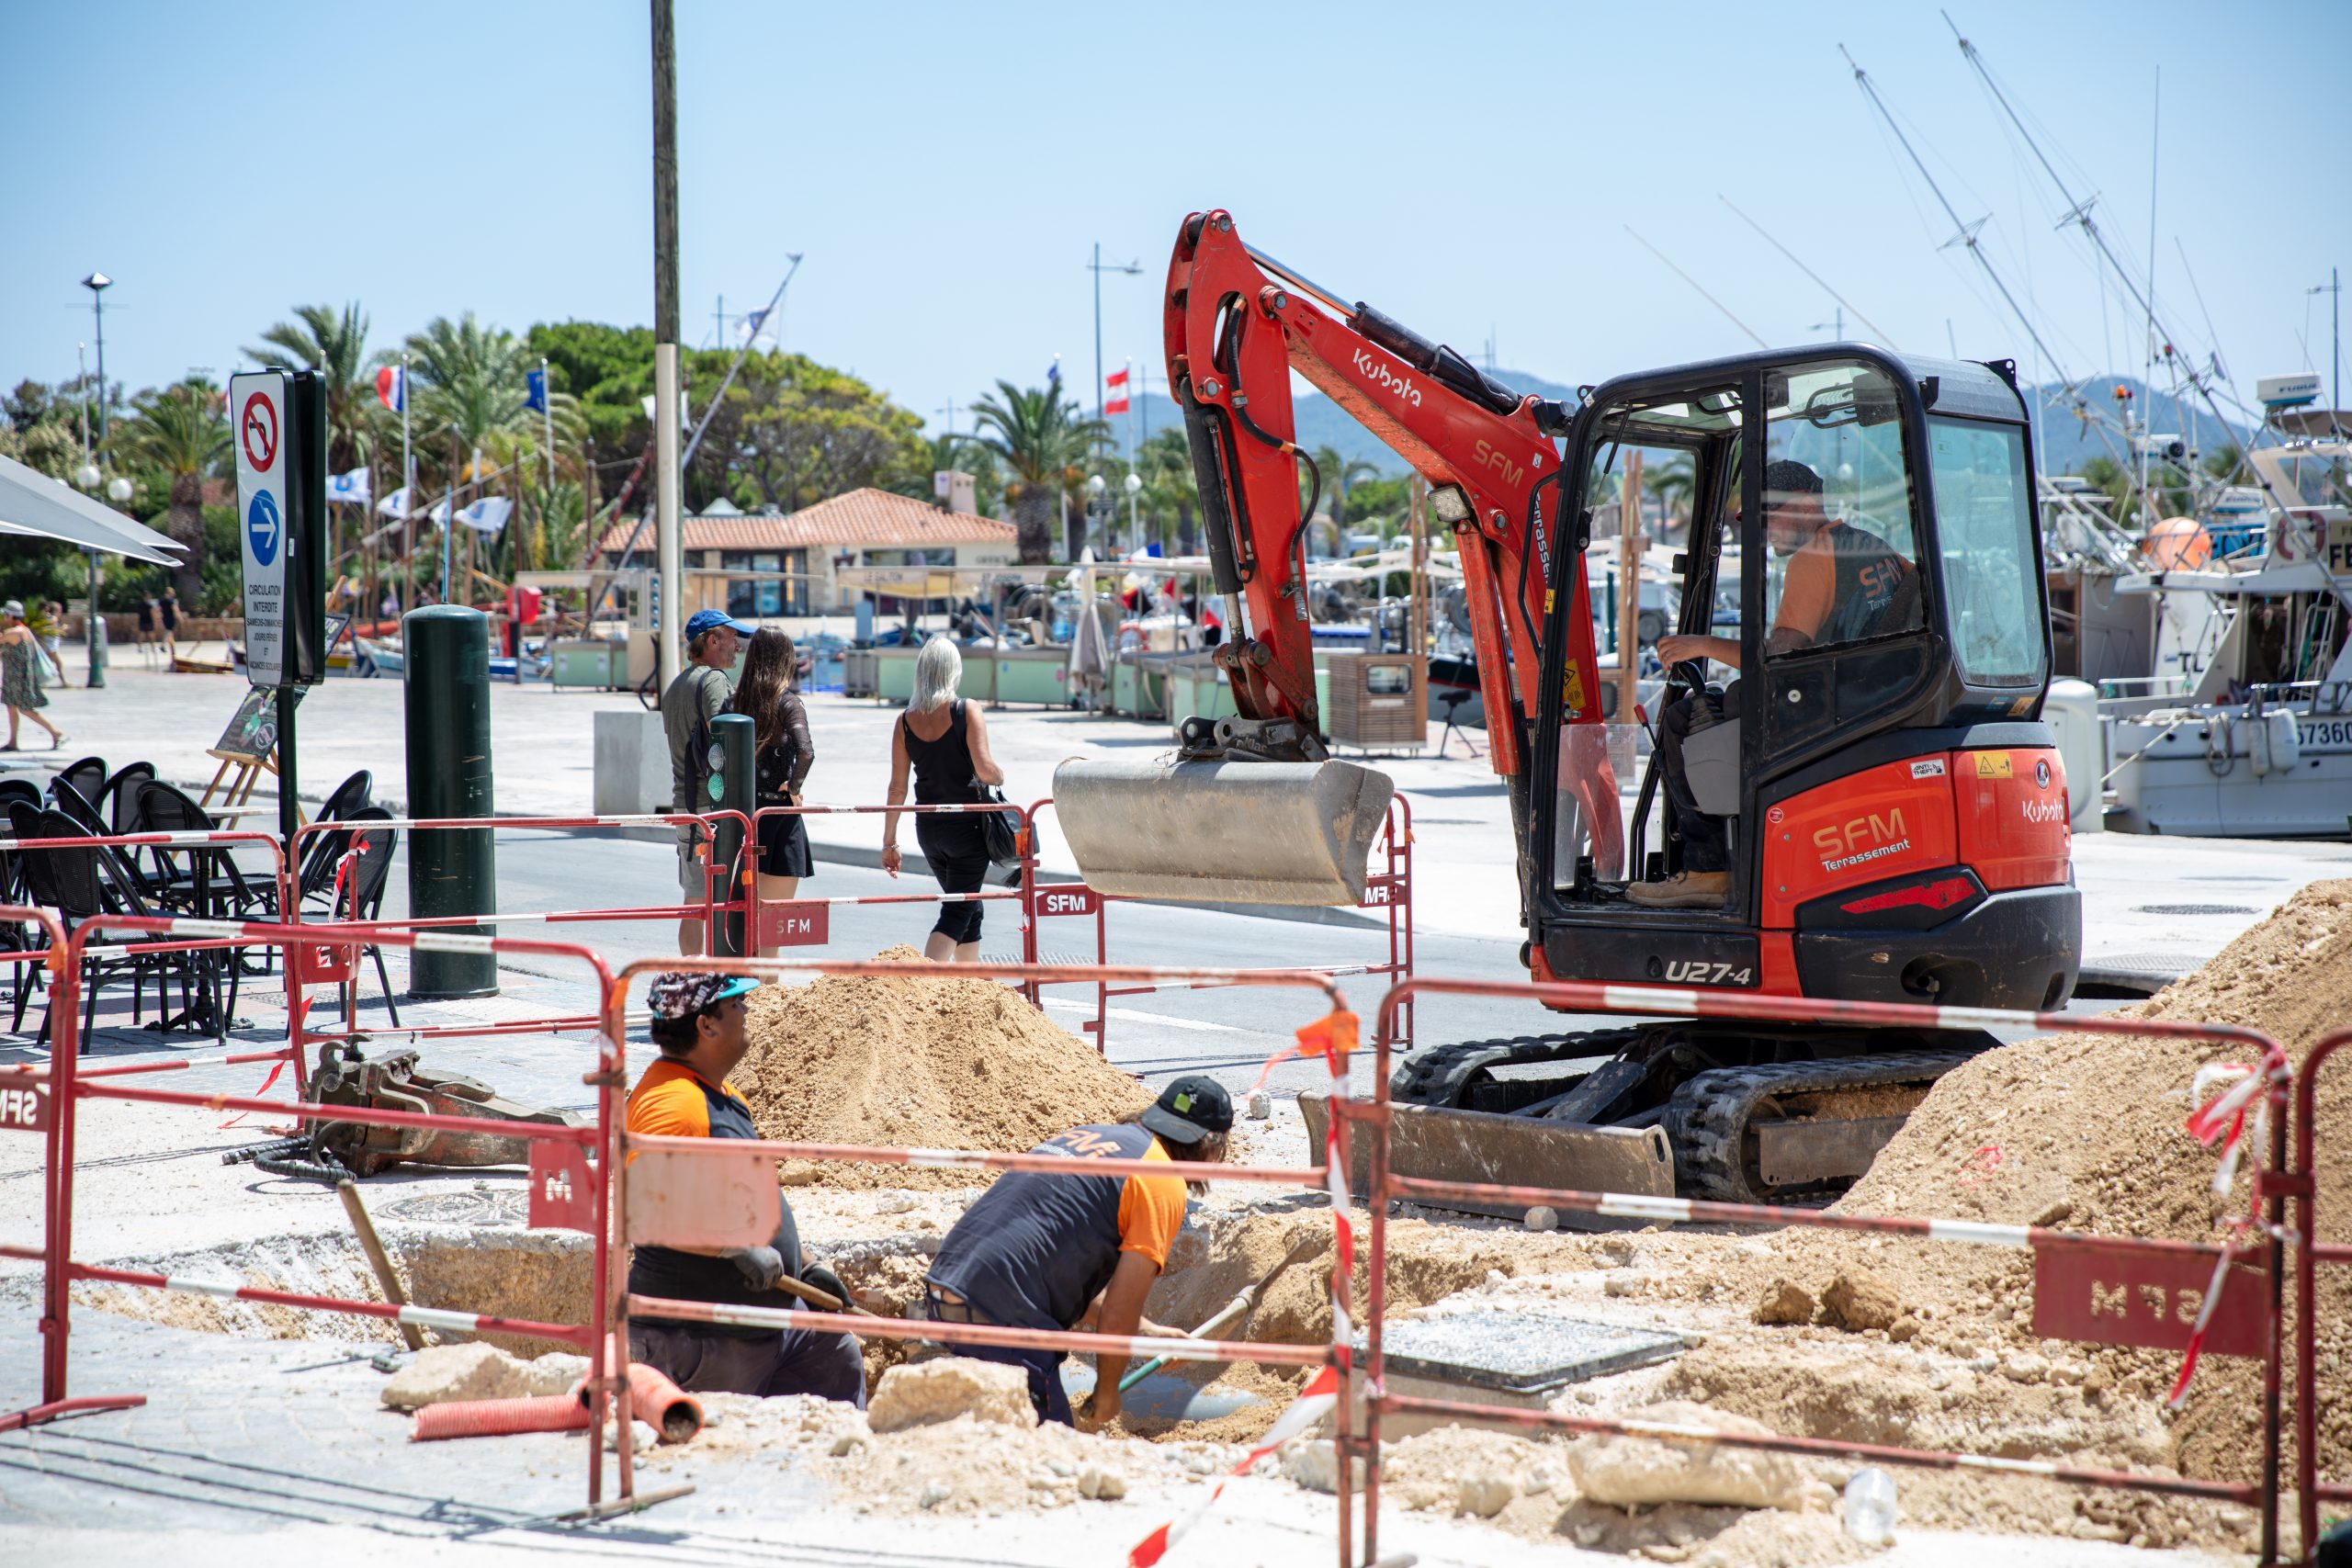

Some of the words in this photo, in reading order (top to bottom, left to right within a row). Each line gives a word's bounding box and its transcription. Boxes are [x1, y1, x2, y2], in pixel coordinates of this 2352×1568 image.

[1352, 347, 1422, 409] Kubota
[1471, 438, 1525, 489] SFM
[249, 584, 281, 596] CIRCULATION
[253, 602, 278, 613] INTERDITE
[2022, 797, 2064, 823] Kubota
[1813, 807, 1907, 862] SFM
[1822, 837, 1911, 873] Terrassement
[1046, 894, 1086, 912] SFM
[775, 918, 811, 934] SFM
[1665, 960, 1752, 985] U27-4
